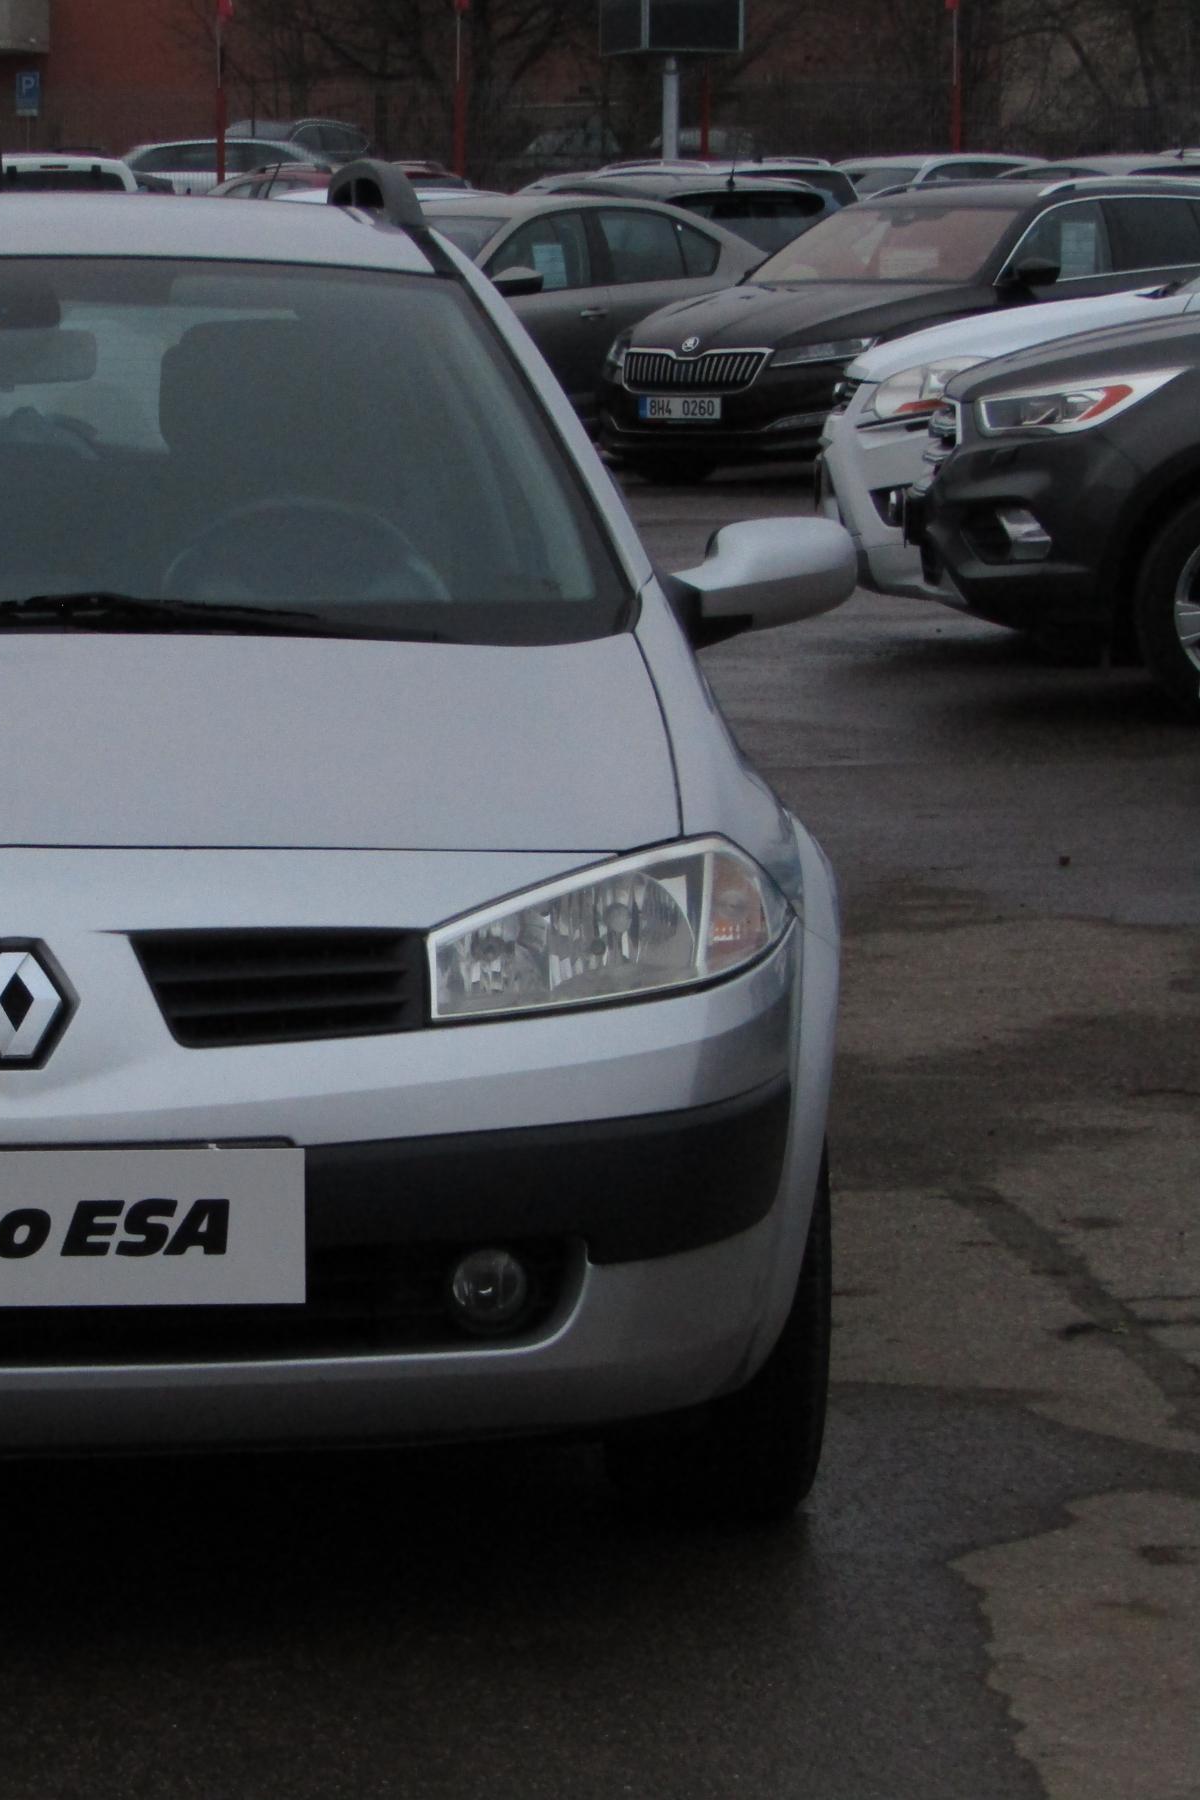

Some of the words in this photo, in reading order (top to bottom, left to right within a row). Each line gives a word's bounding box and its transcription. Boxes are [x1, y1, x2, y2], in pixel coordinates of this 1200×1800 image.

[21, 76, 35, 96] P
[649, 399, 672, 416] 8H4
[682, 399, 715, 416] 0260
[60, 1198, 231, 1257] ESA
